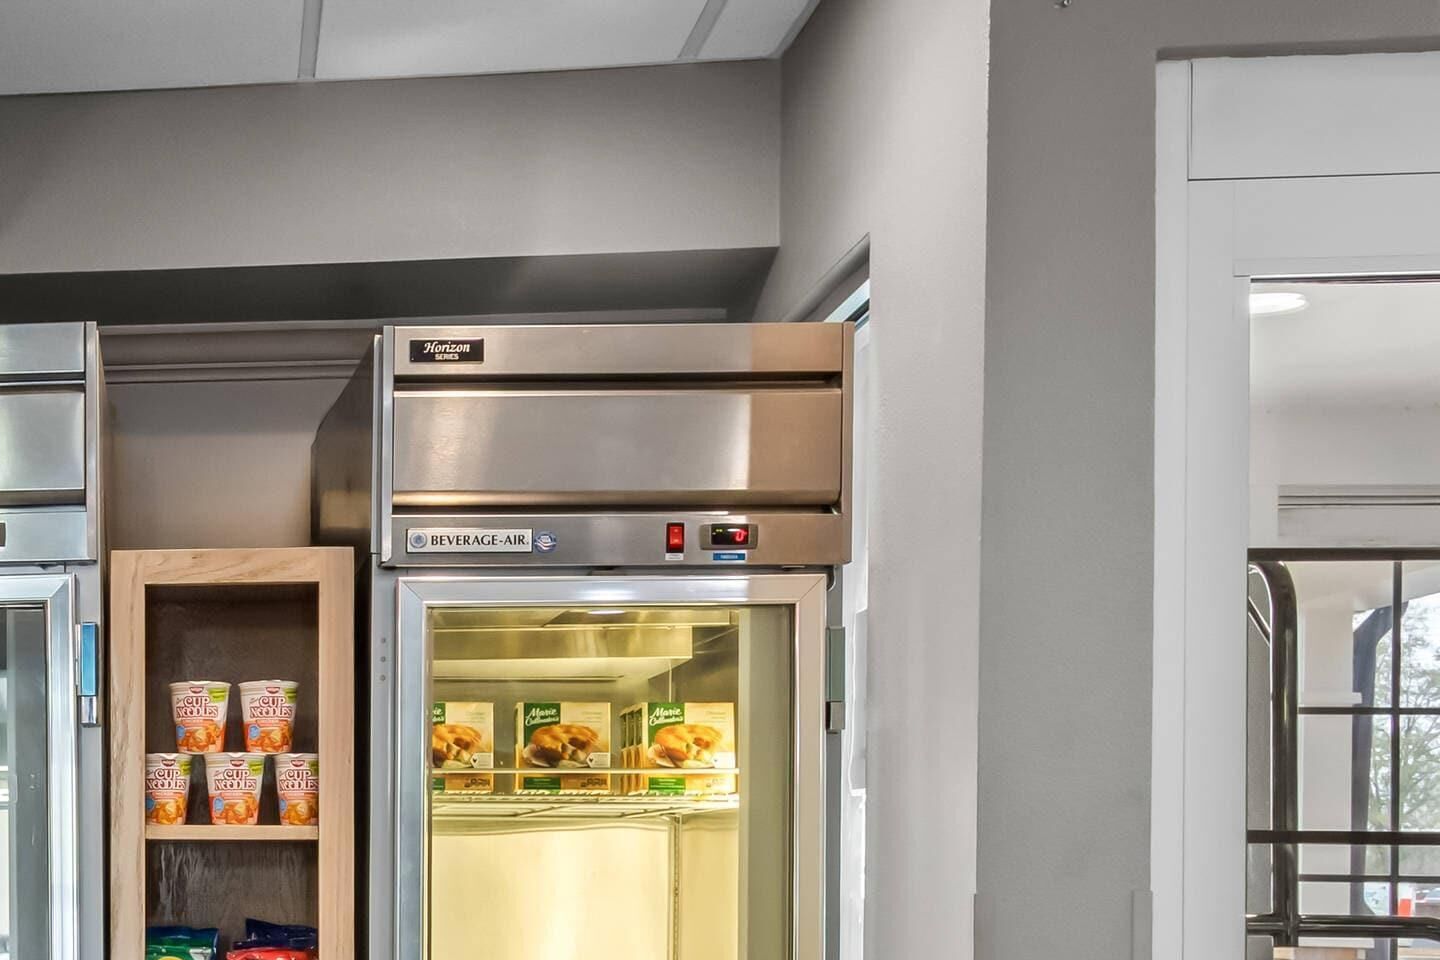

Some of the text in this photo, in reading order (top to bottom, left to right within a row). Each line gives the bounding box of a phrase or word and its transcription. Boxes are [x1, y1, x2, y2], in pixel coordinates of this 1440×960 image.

[424, 341, 470, 353] Horizon
[434, 353, 460, 361] SERIES
[184, 696, 210, 707] CUP
[259, 696, 286, 707] CUP
[176, 706, 218, 718] NOODLES
[250, 706, 293, 718] NOODLES
[155, 769, 180, 780] CUP
[223, 769, 250, 780] CUP
[286, 769, 312, 780] CUP
[147, 779, 186, 790] NOODLES
[215, 779, 257, 790] NOODLES
[279, 779, 319, 790] NOODLES
